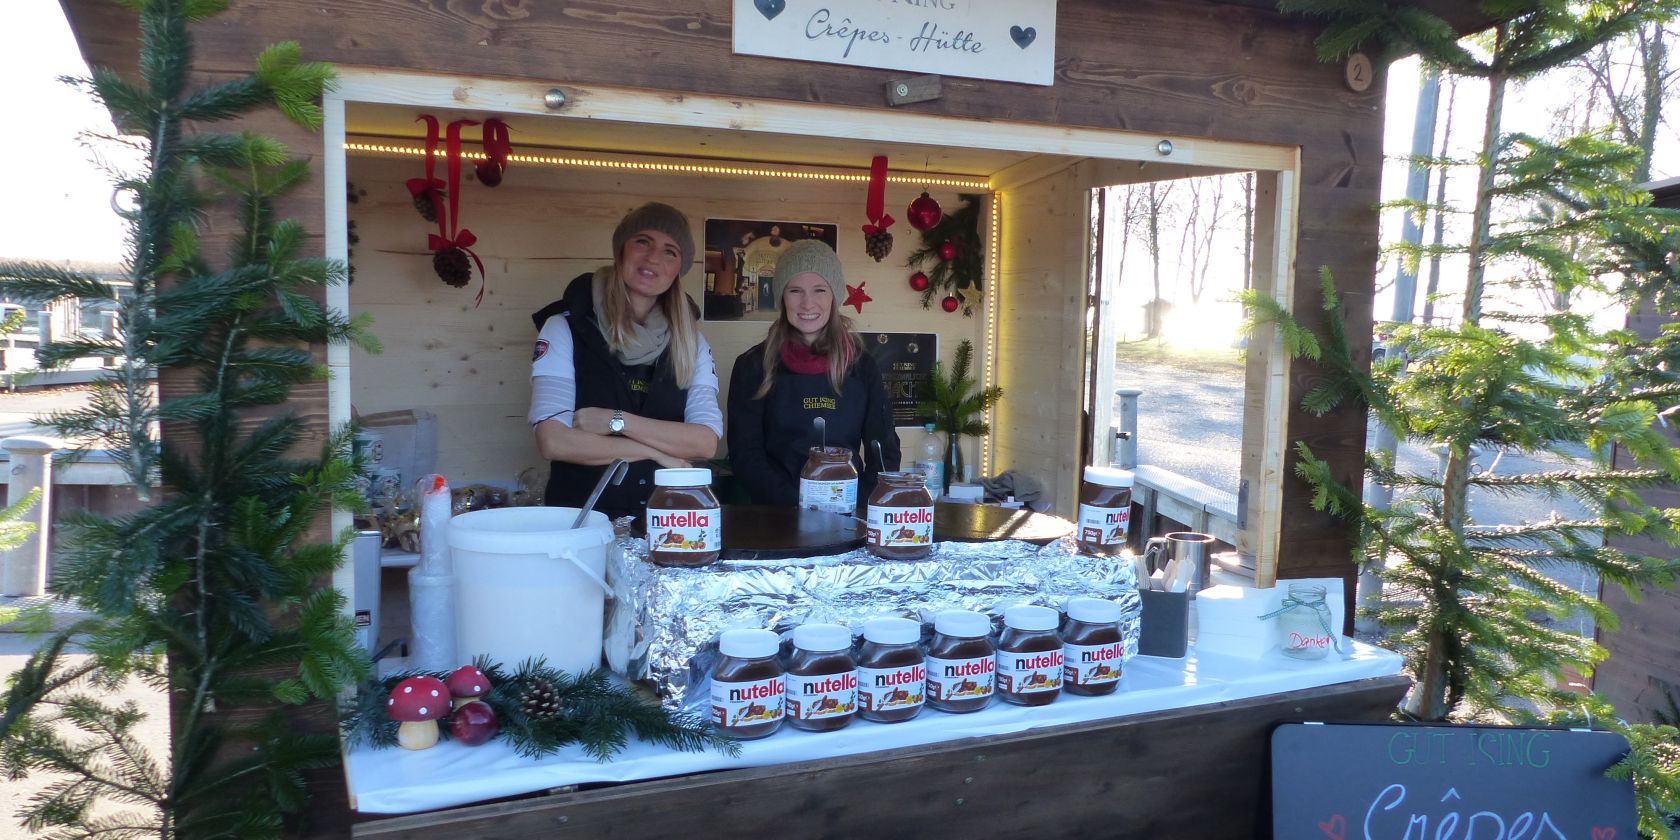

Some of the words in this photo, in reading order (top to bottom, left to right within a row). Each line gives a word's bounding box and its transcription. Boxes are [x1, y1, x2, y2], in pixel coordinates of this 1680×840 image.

[804, 9, 891, 58] Crêpes
[910, 21, 985, 54] Hütte
[1353, 63, 1364, 82] 2
[651, 511, 709, 528] nutella
[884, 508, 932, 524] nutella
[1106, 508, 1130, 524] nutel
[1015, 651, 1064, 670] nutella
[1081, 643, 1125, 662] nutella
[875, 666, 926, 686] nutella
[944, 658, 995, 677] nutella
[729, 679, 785, 701] nutella
[803, 673, 857, 694] nutella
[1388, 732, 1455, 765] GUT
